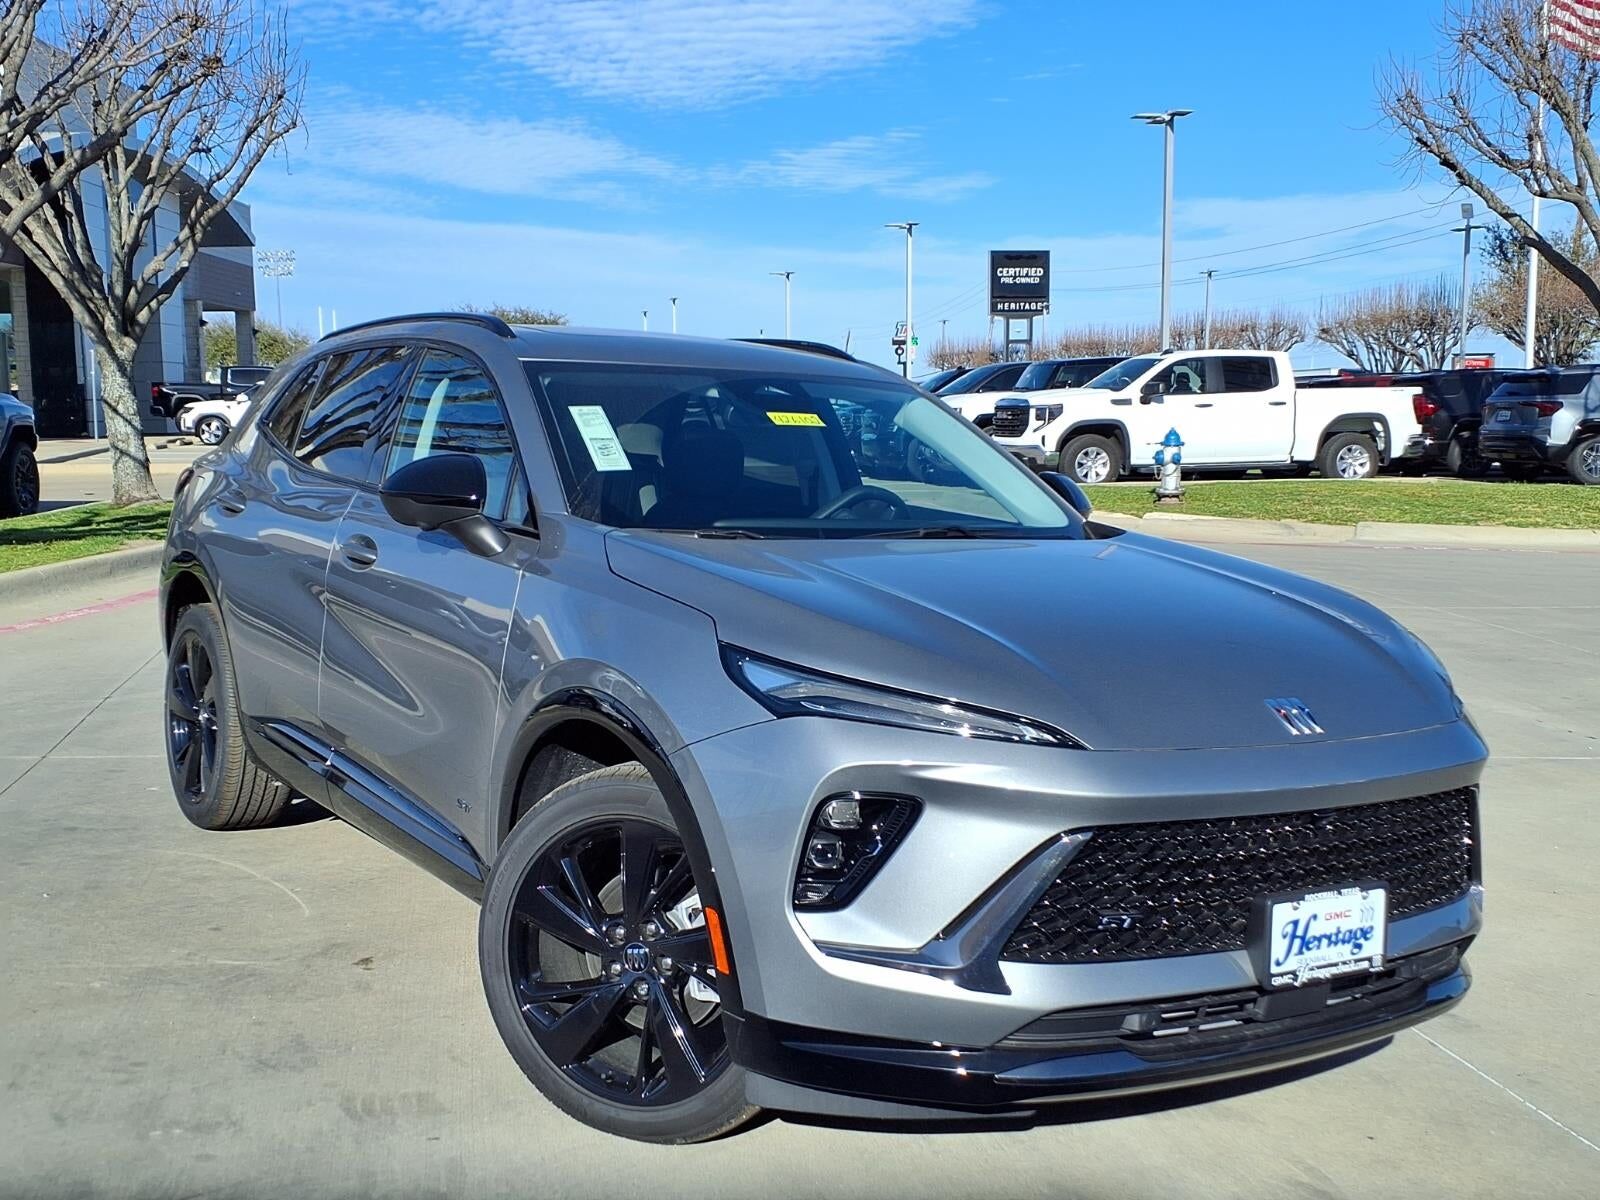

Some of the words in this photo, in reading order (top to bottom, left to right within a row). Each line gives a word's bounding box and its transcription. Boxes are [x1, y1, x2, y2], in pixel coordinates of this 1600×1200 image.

[997, 267, 1044, 277] CERTIFIED
[997, 302, 1044, 311] HERITAGE
[1324, 909, 1353, 921] GMC
[1274, 913, 1374, 967] Heritage
[1271, 974, 1295, 986] GMC
